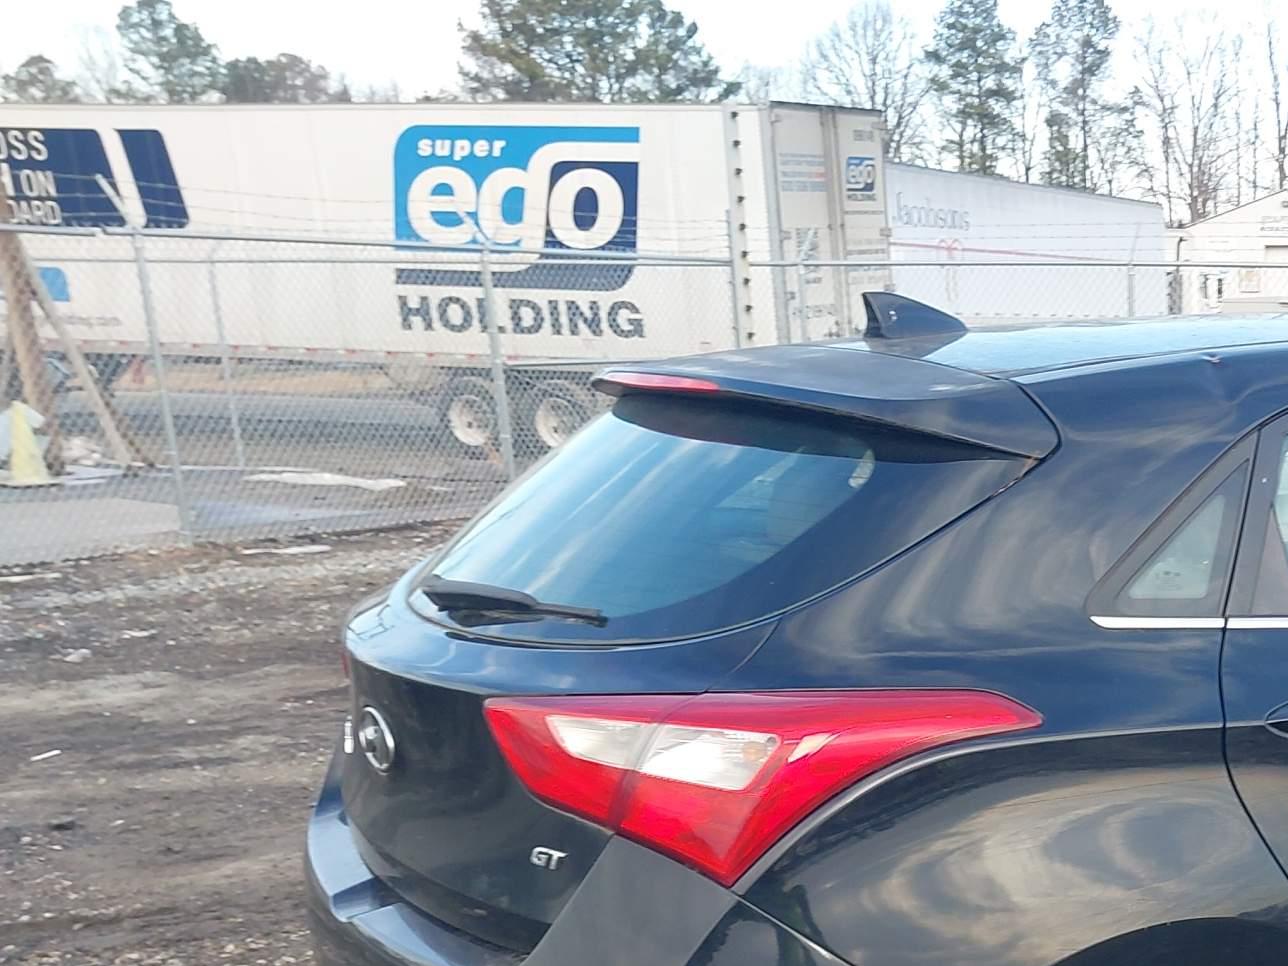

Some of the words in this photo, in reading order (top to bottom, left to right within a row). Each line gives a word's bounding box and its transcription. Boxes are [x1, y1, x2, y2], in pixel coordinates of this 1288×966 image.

[416, 138, 507, 161] super
[20, 169, 58, 198] ON
[405, 165, 625, 264] ego
[398, 295, 646, 339] HOLDING
[530, 846, 568, 870] GT
